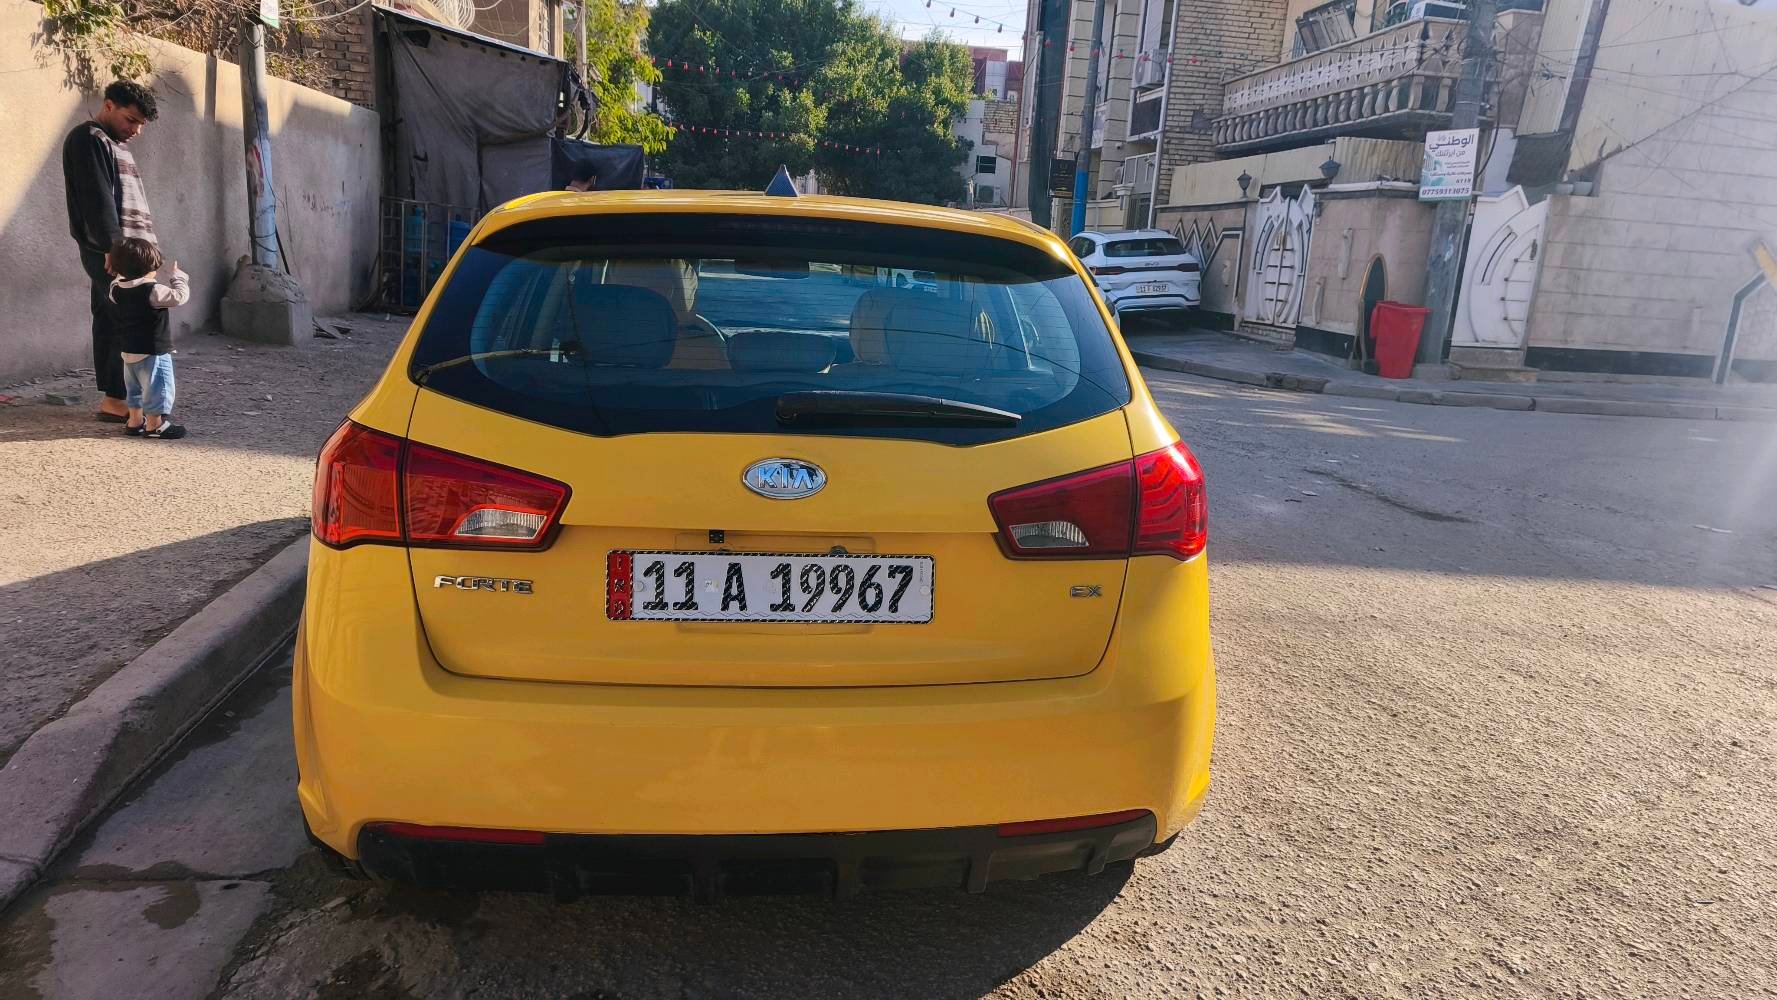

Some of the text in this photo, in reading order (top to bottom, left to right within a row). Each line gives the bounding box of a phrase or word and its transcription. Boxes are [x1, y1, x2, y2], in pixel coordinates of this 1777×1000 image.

[1429, 134, 1474, 153] الوطني
[758, 466, 814, 490] KIA
[433, 575, 534, 594] FORTE
[643, 560, 699, 611] 11
[720, 561, 748, 612] A
[769, 562, 914, 614] 19967
[1070, 584, 1104, 598] EX
